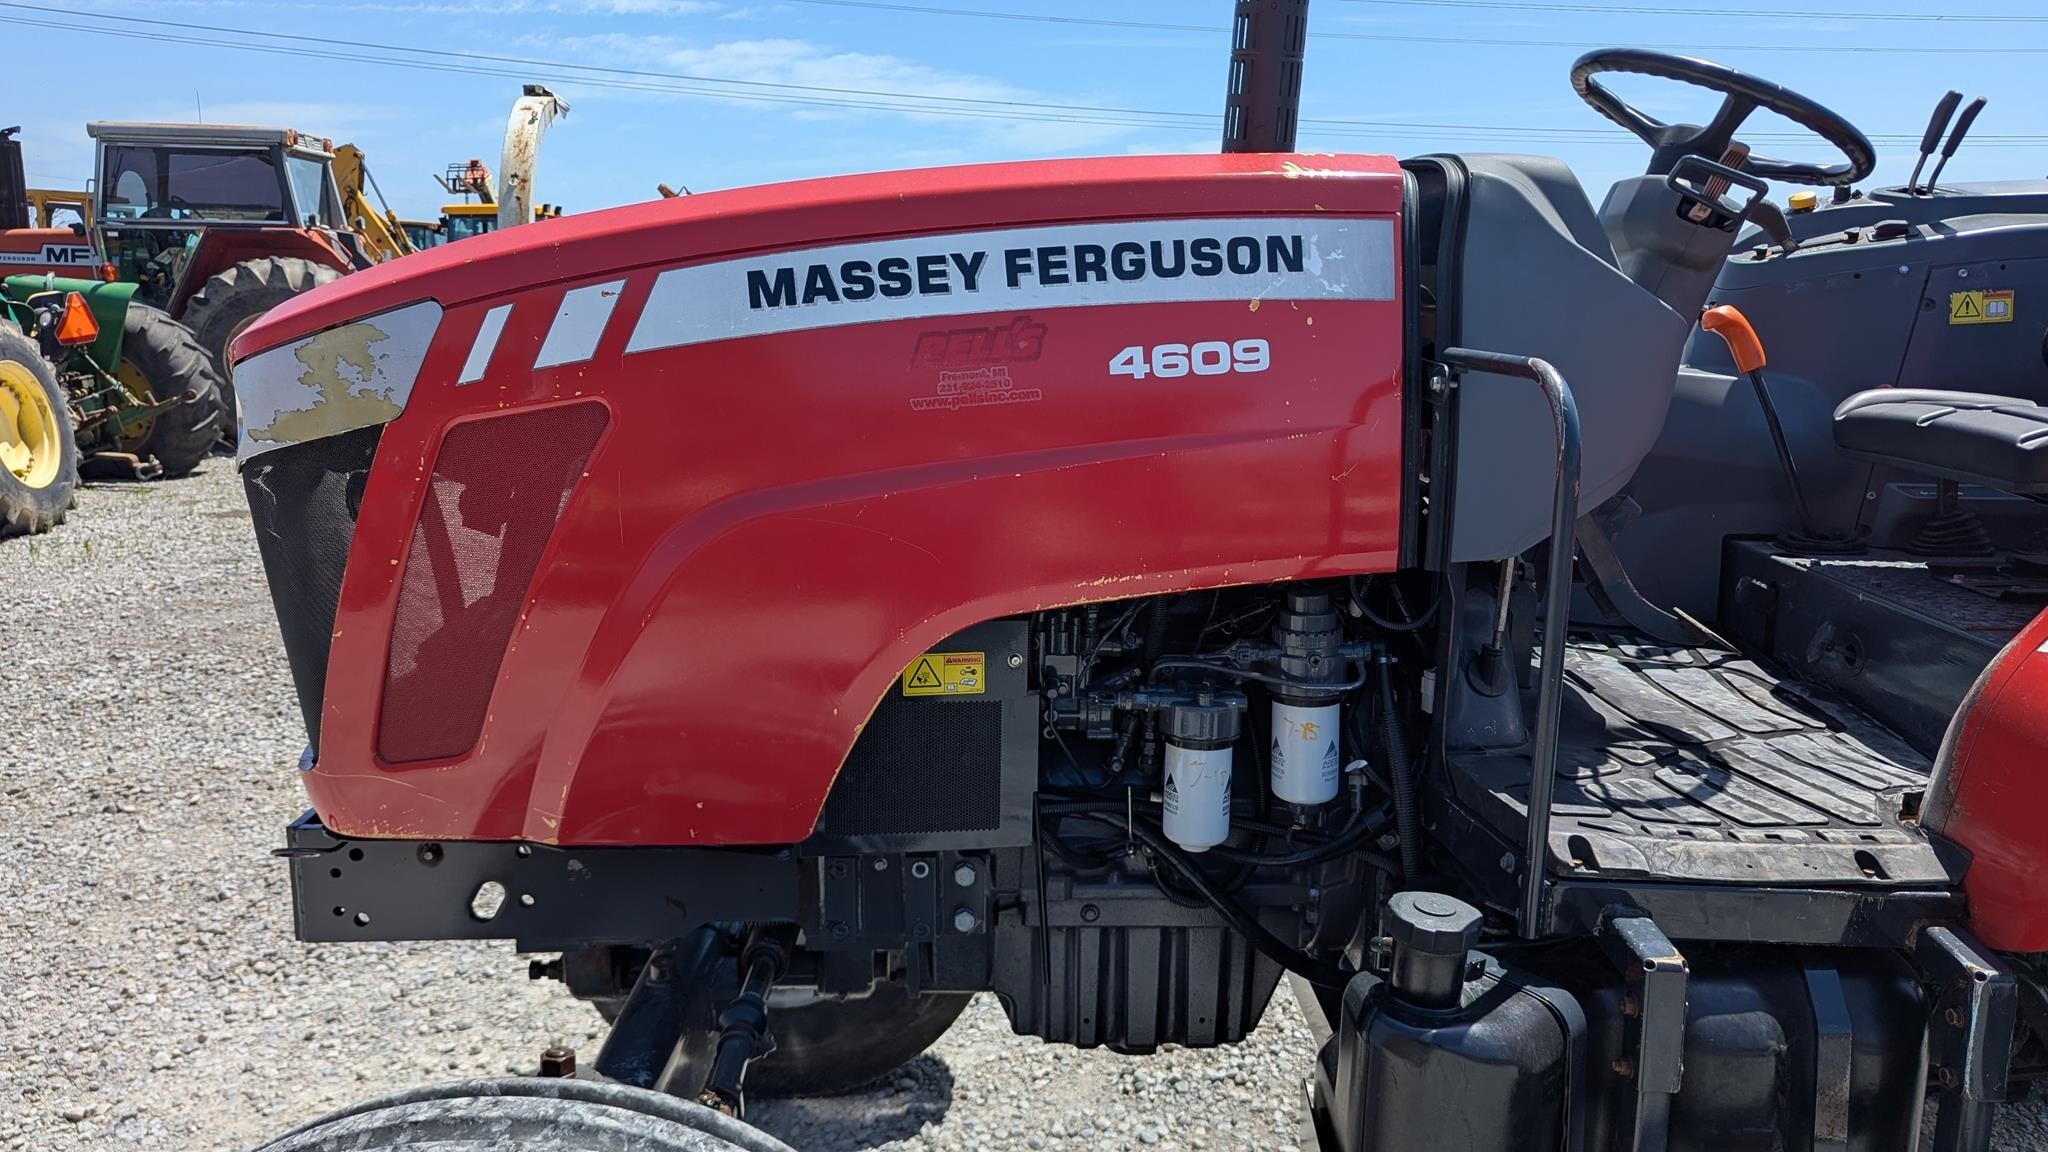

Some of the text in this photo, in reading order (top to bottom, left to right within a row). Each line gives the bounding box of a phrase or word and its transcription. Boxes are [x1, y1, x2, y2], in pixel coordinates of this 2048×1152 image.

[46, 247, 90, 263] MF
[747, 235, 1304, 310] MASSEY FERGUSON
[1109, 339, 1270, 379] 4609
